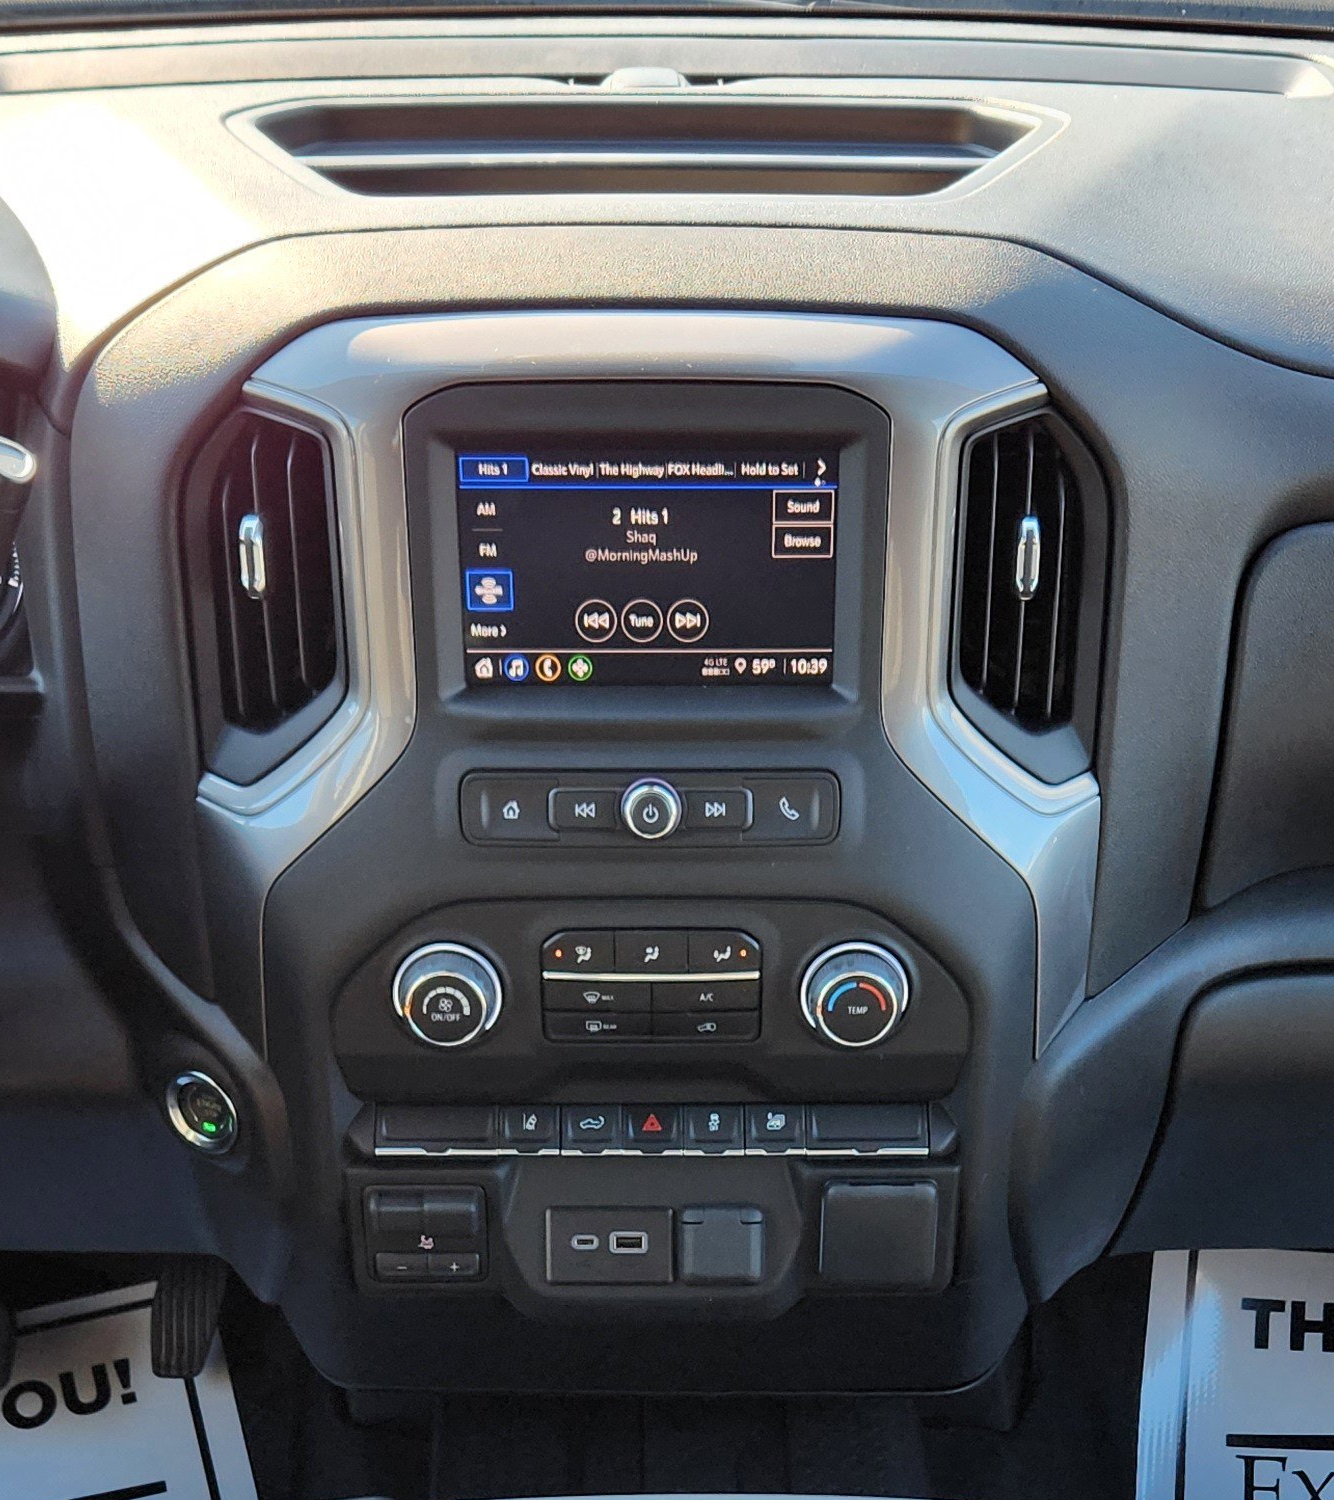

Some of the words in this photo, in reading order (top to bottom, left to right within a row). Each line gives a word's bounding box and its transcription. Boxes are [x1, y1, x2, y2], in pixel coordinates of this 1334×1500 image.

[478, 462, 500, 476] Hits
[501, 462, 508, 476] 1
[531, 462, 567, 476] Classic
[568, 462, 594, 478] Vinyl
[599, 462, 618, 476] The
[620, 462, 664, 478] Highway
[667, 462, 690, 476] FOX
[741, 462, 766, 476] Hold
[767, 462, 779, 476] to
[780, 462, 799, 476] Set
[476, 503, 496, 517] AM
[786, 499, 820, 515] Sound
[611, 507, 622, 525] 2
[630, 507, 658, 526] Hits
[661, 507, 669, 525] 1
[626, 530, 657, 547] Shaq
[783, 535, 822, 549] Browse
[479, 543, 497, 557] FM
[584, 548, 699, 565] @MorningMashUp
[629, 614, 654, 628] Tune
[470, 623, 499, 638] More
[715, 658, 728, 667] LTE
[790, 658, 828, 675] 10:39
[699, 993, 714, 1002] A/C
[431, 1013, 460, 1022] ON/OFF
[847, 1006, 869, 1015] TEMP
